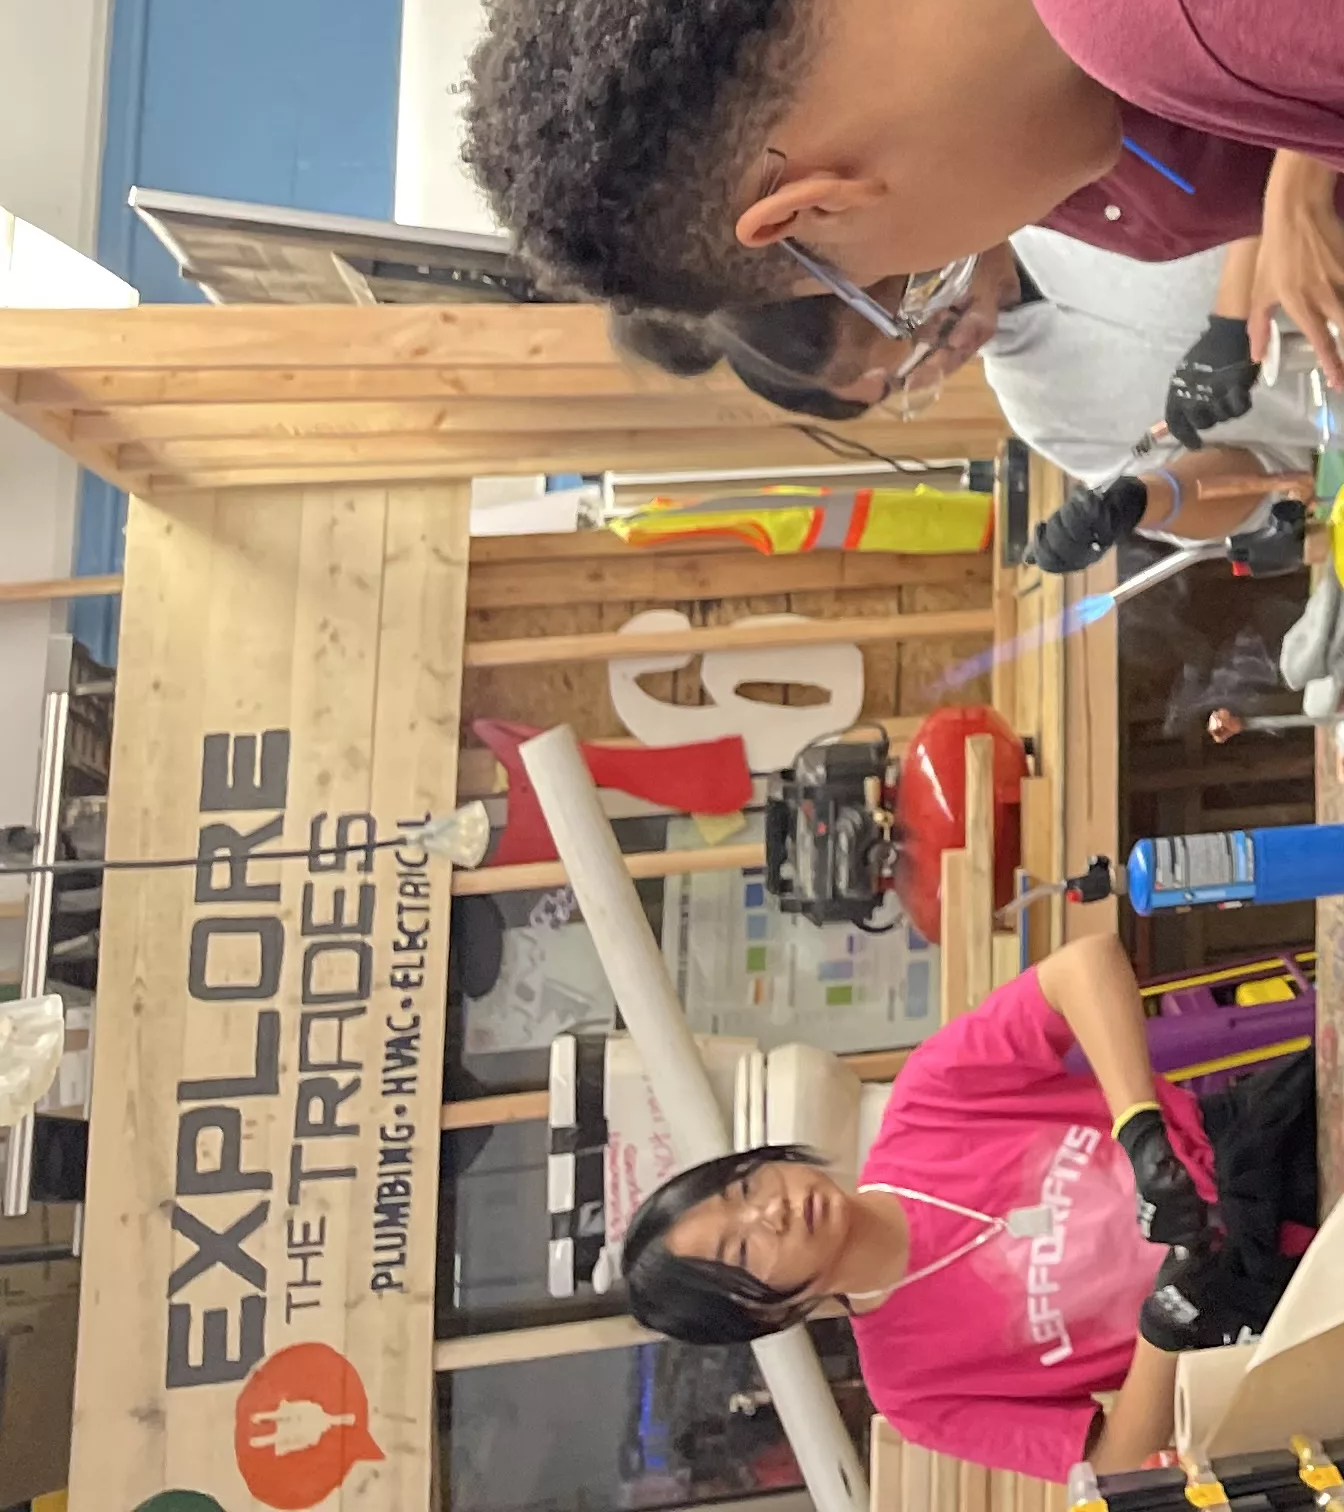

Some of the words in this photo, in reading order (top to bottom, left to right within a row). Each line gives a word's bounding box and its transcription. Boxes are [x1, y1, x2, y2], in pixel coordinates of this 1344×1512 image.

[390, 812, 431, 989] ELECTRICL
[164, 727, 290, 1389] EXPLORE
[286, 810, 377, 1206] TRADES
[380, 1014, 420, 1097] HVAC
[285, 1215, 326, 1323] THE
[370, 1124, 415, 1292] PLUMBING
